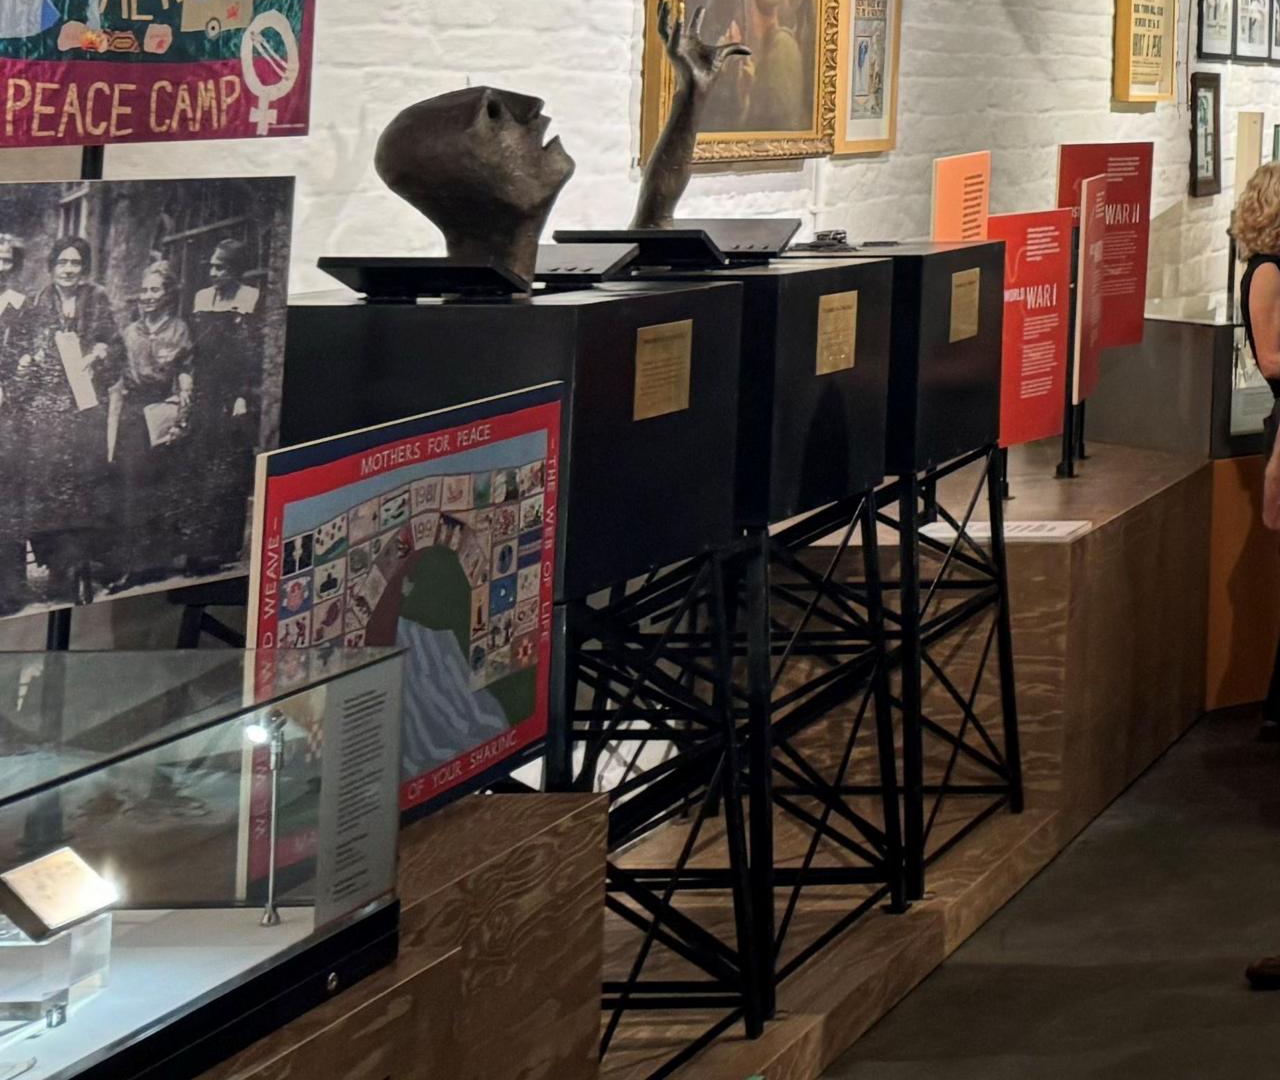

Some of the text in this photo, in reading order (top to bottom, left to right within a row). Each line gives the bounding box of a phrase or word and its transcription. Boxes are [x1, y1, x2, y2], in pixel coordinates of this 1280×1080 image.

[5, 73, 241, 138] PEACE CAMP
[1104, 205, 1130, 225] WAR
[1026, 283, 1051, 310] WAR
[360, 423, 491, 476] MOTHERS FOR PEACE
[263, 536, 280, 619] WEAVE
[540, 455, 557, 643] THE WEB OF LIFE
[407, 728, 519, 801] OF YOUR SHARING
